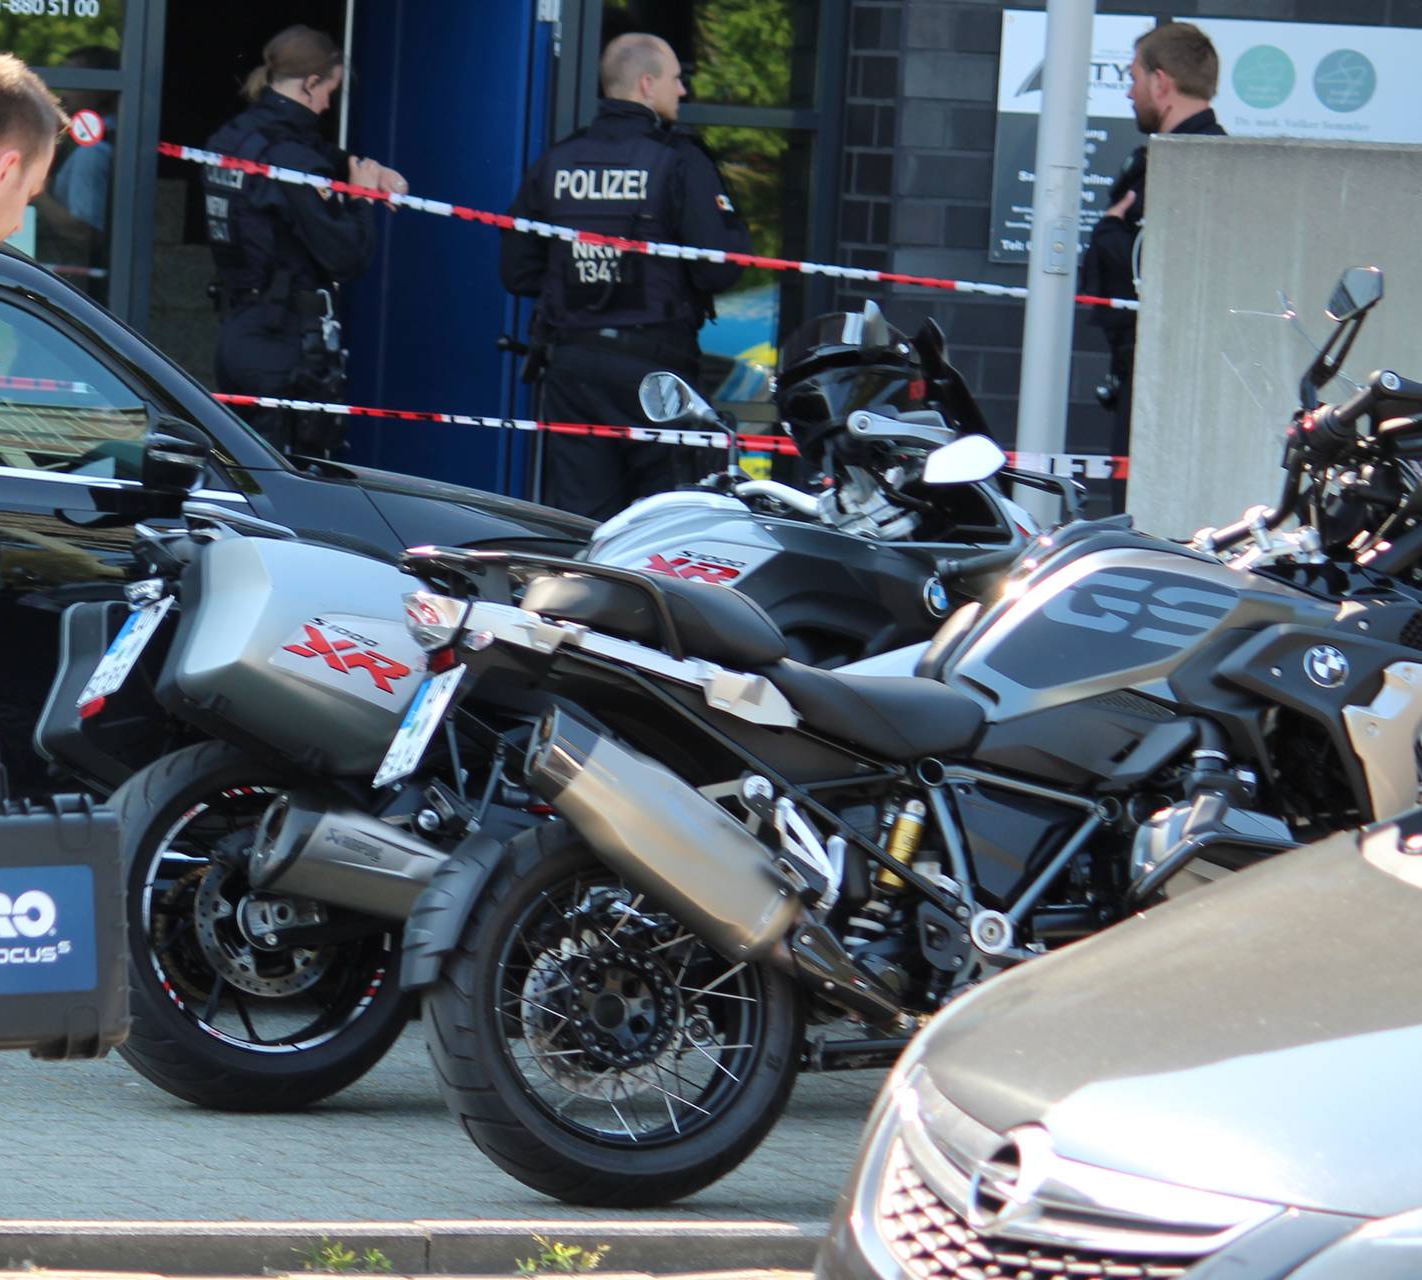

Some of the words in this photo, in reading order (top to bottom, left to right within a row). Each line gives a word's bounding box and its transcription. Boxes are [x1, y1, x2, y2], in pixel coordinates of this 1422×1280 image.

[47, 0, 69, 17] 51
[74, 0, 100, 18] 00
[554, 168, 649, 200] POLIZEI
[1042, 570, 1240, 649] GS
[331, 623, 379, 648] 1000
[281, 622, 412, 696] XR
